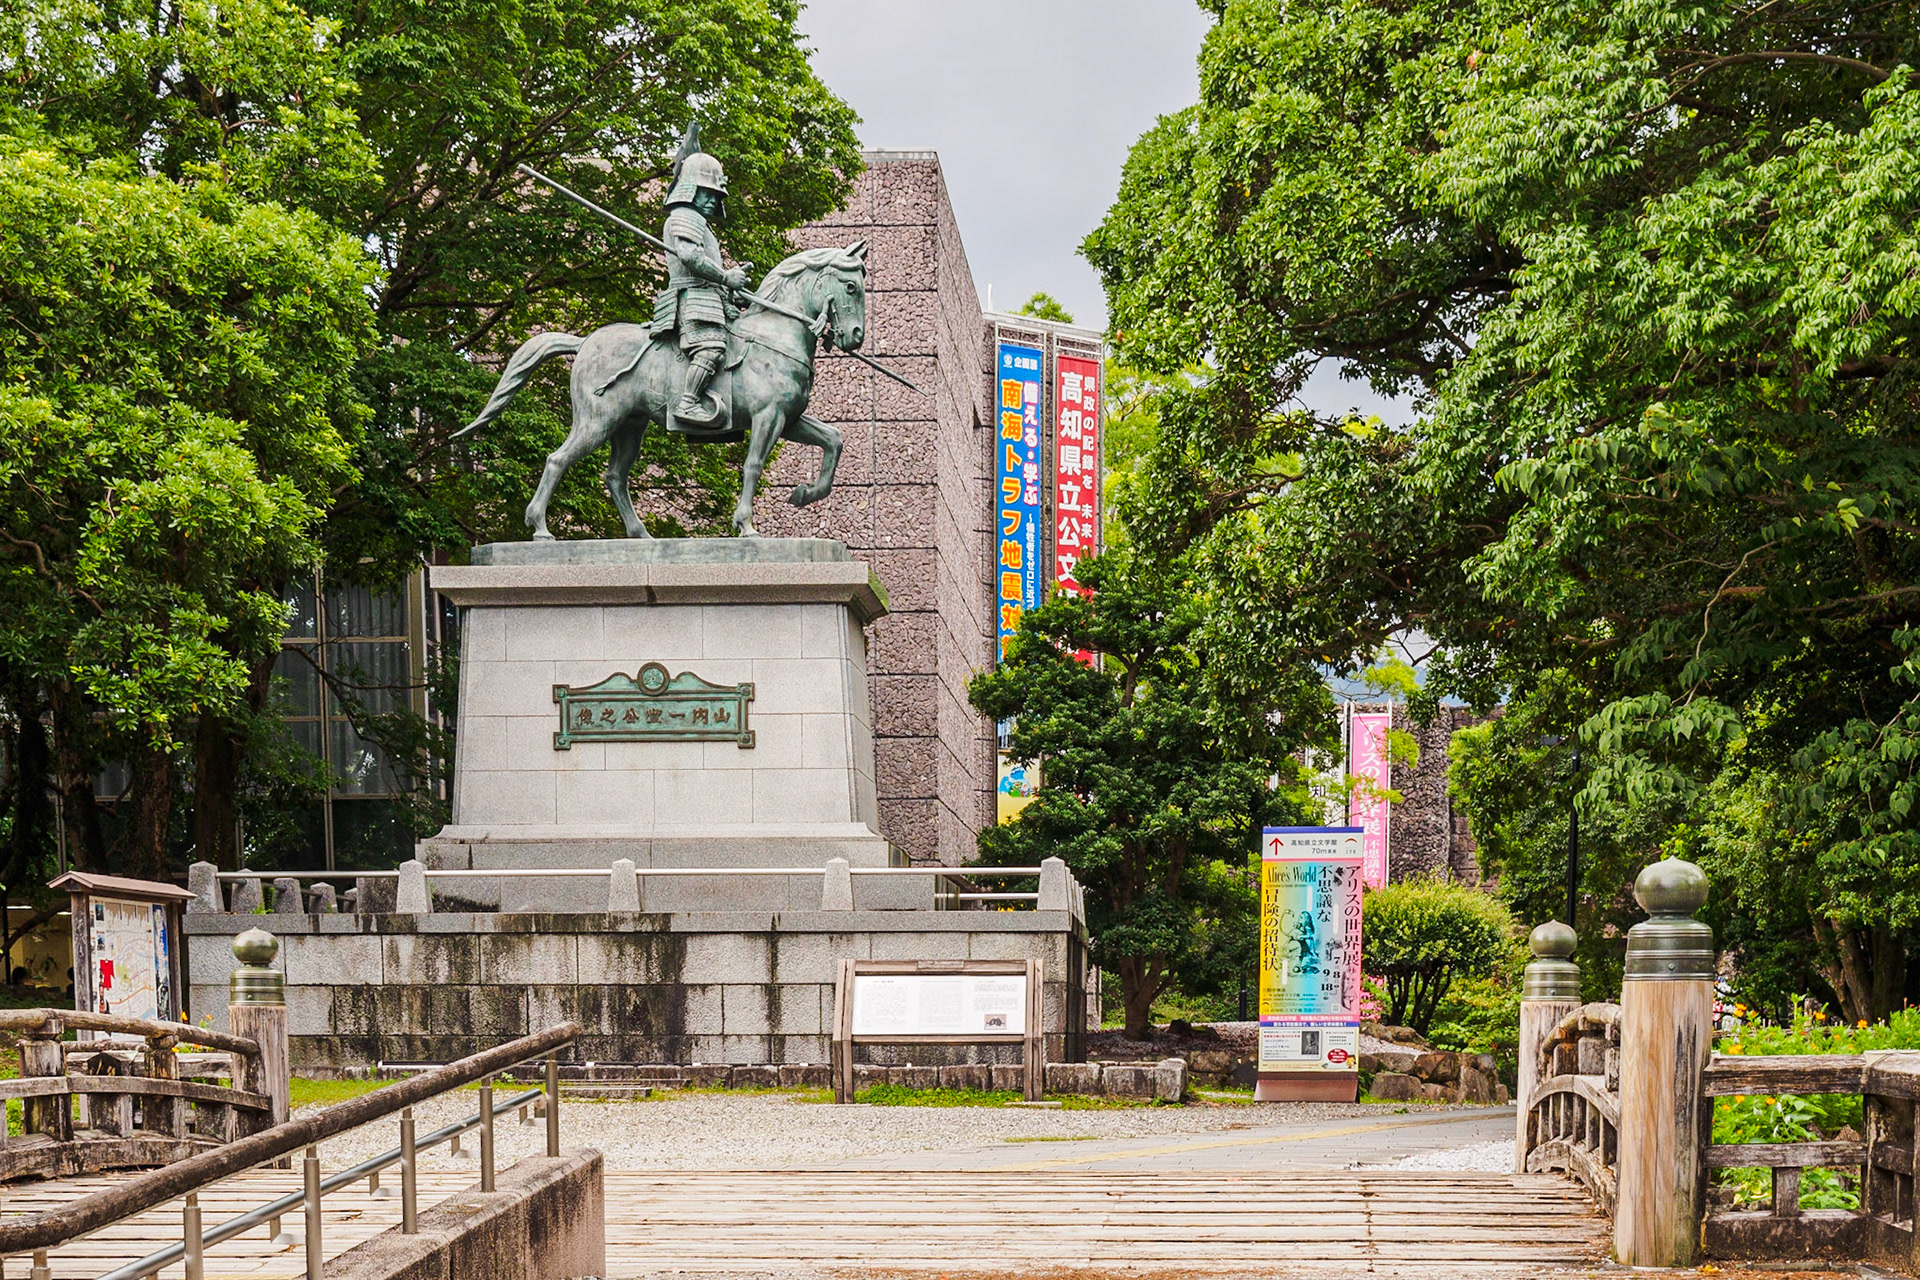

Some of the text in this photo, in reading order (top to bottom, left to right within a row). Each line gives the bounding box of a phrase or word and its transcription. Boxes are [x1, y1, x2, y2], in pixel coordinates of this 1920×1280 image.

[1058, 371, 1084, 597] 高知県立公文
[1293, 866, 1317, 883] World
[1316, 865, 1333, 923] 不思議な
[1342, 865, 1361, 966] アリスの世界展
[1262, 888, 1279, 971] 冒険の招待状
